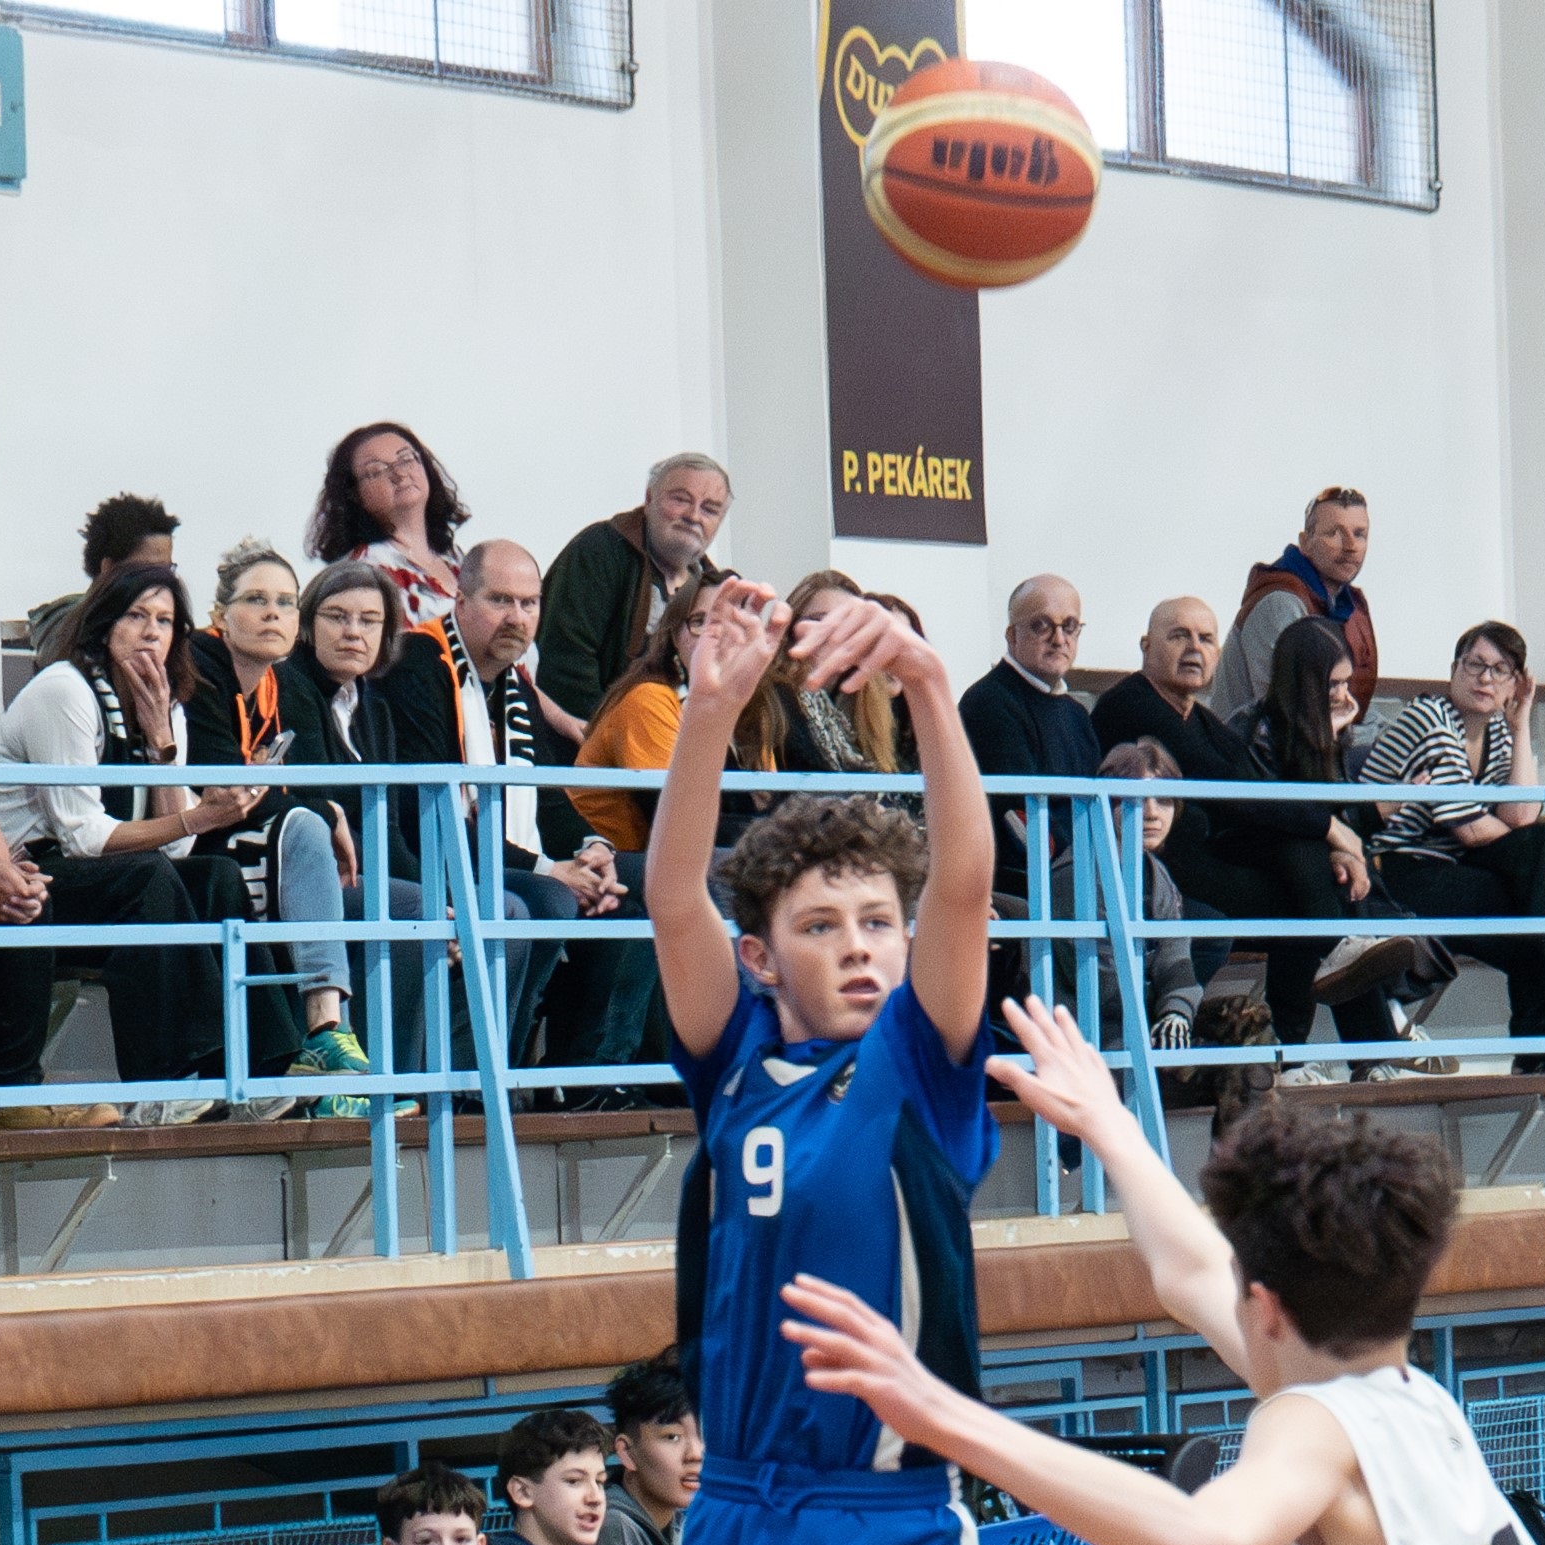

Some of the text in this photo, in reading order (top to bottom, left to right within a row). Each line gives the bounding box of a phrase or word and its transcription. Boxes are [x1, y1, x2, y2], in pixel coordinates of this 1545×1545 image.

[843, 444, 973, 501] P. PEKÁREK
[742, 1126, 785, 1217] 9
